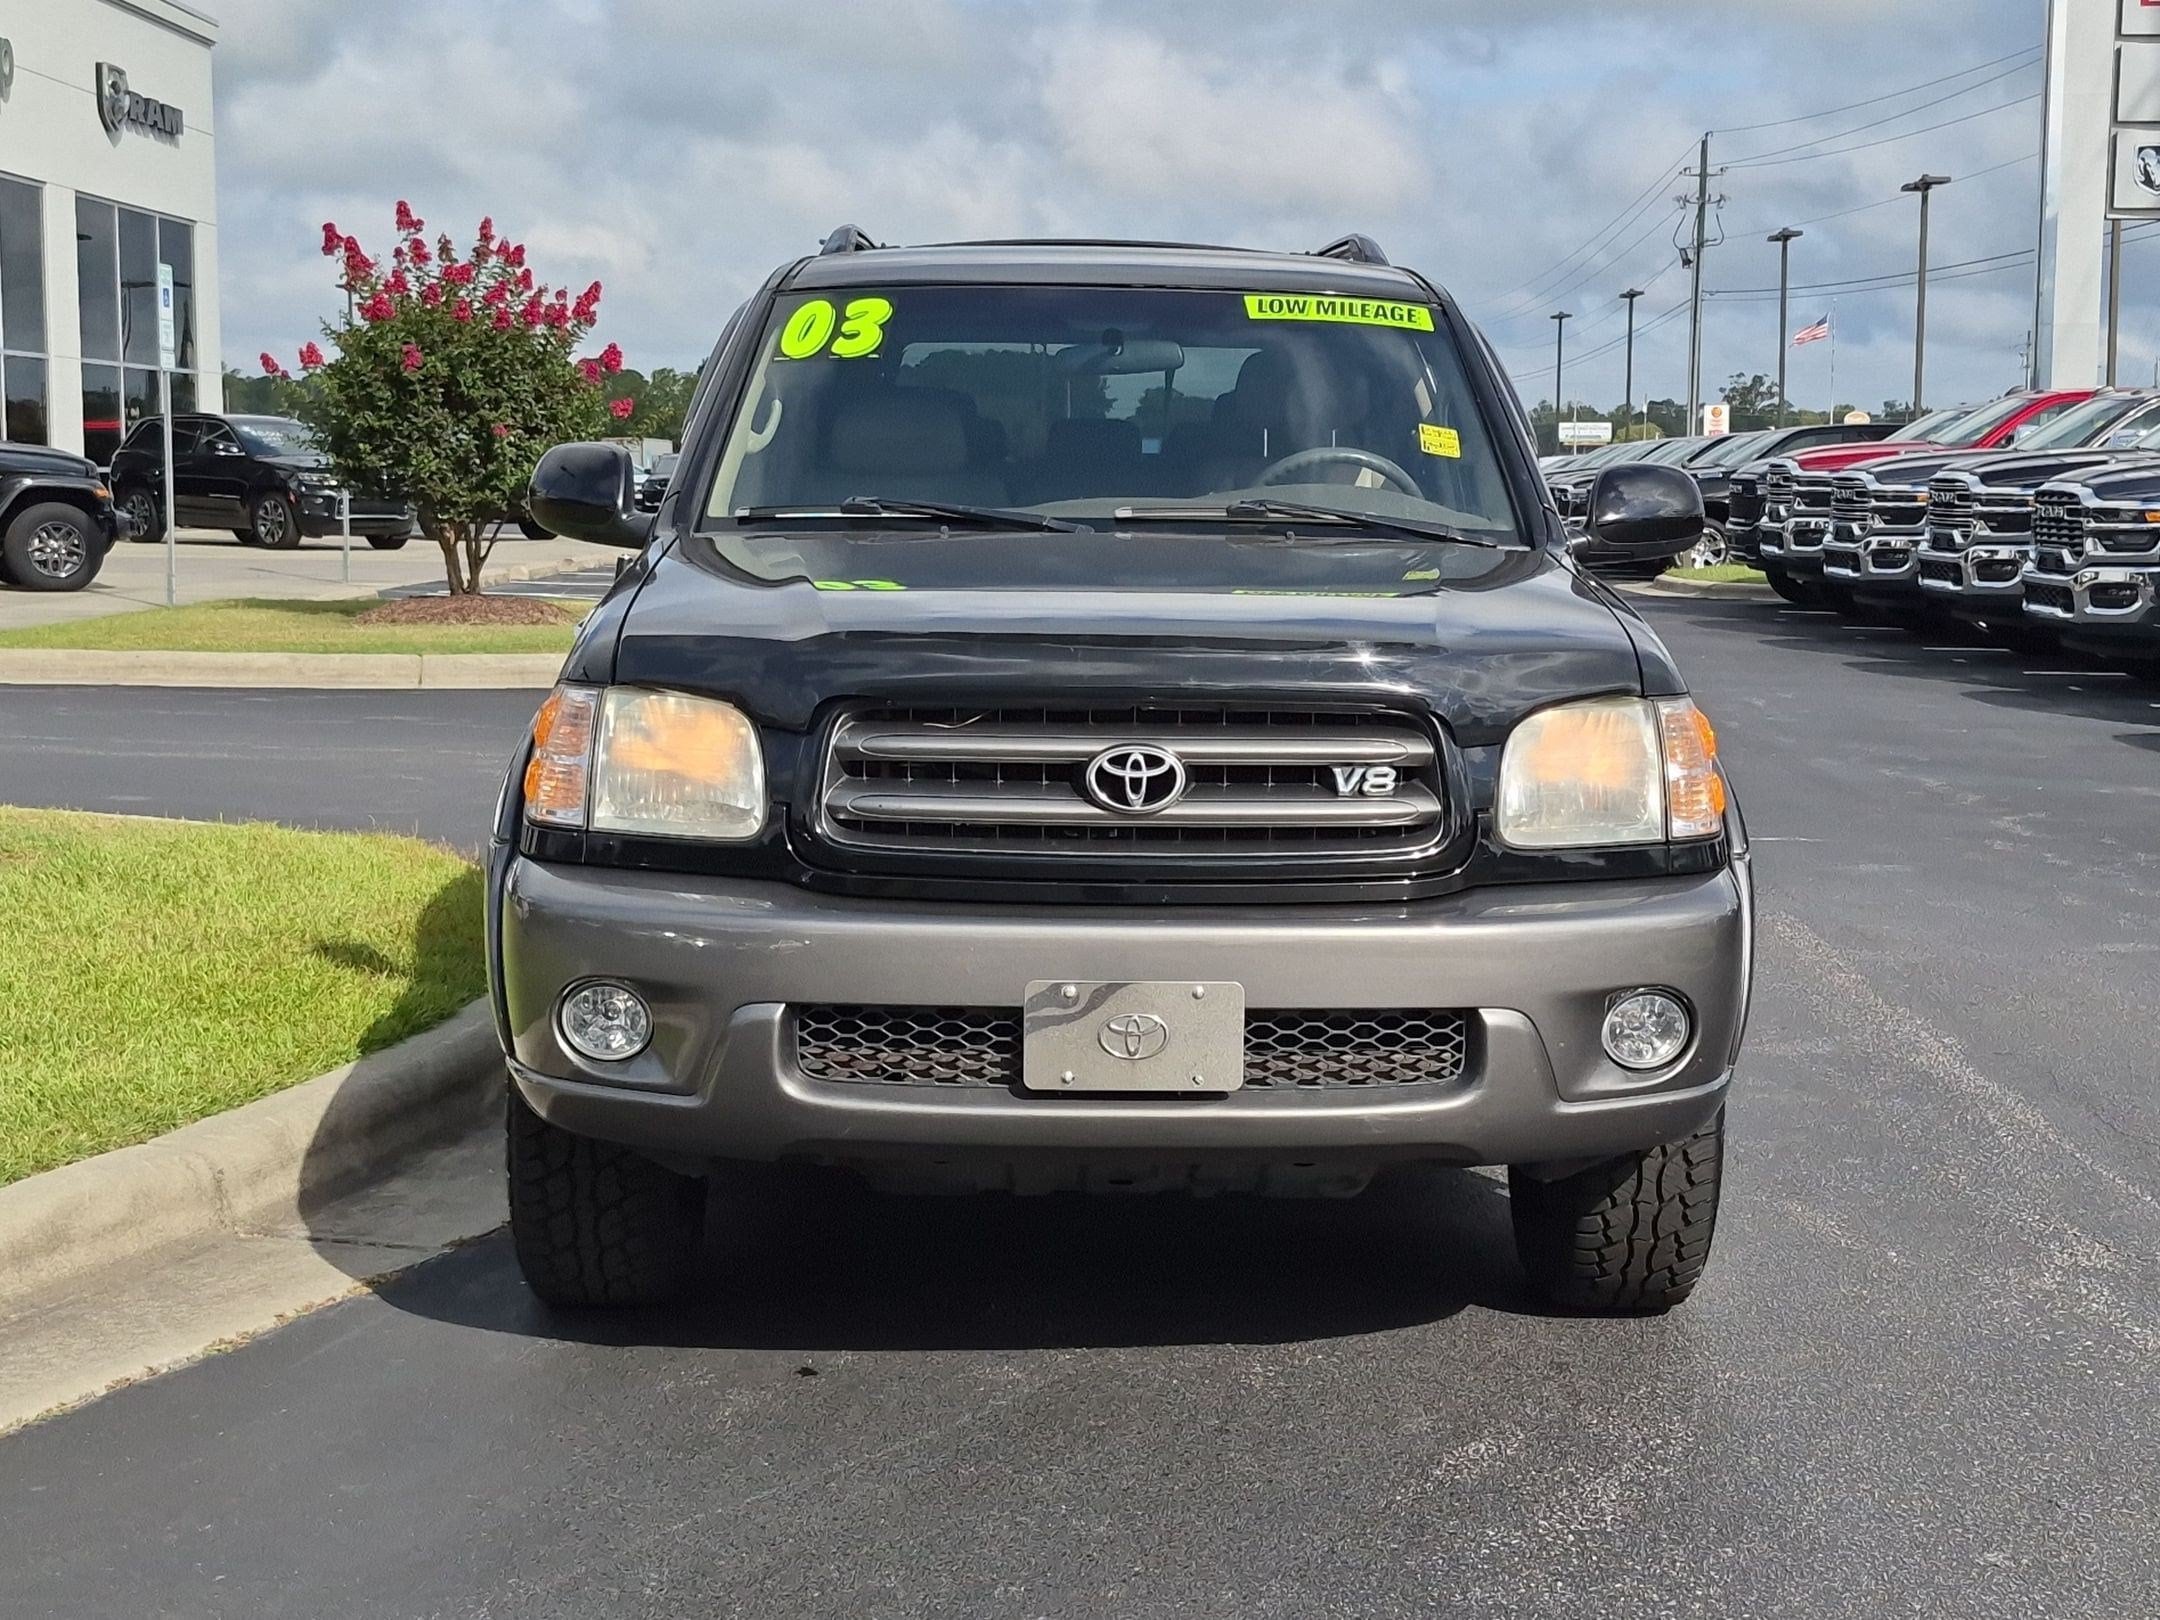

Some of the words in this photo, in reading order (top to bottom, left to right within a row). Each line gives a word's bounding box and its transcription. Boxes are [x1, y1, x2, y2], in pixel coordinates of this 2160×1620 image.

[127, 90, 184, 136] RAM
[780, 298, 893, 359] 03
[1257, 299, 1309, 315] LOW
[1315, 300, 1418, 324] MILEAGE
[1331, 766, 1397, 796] V8
